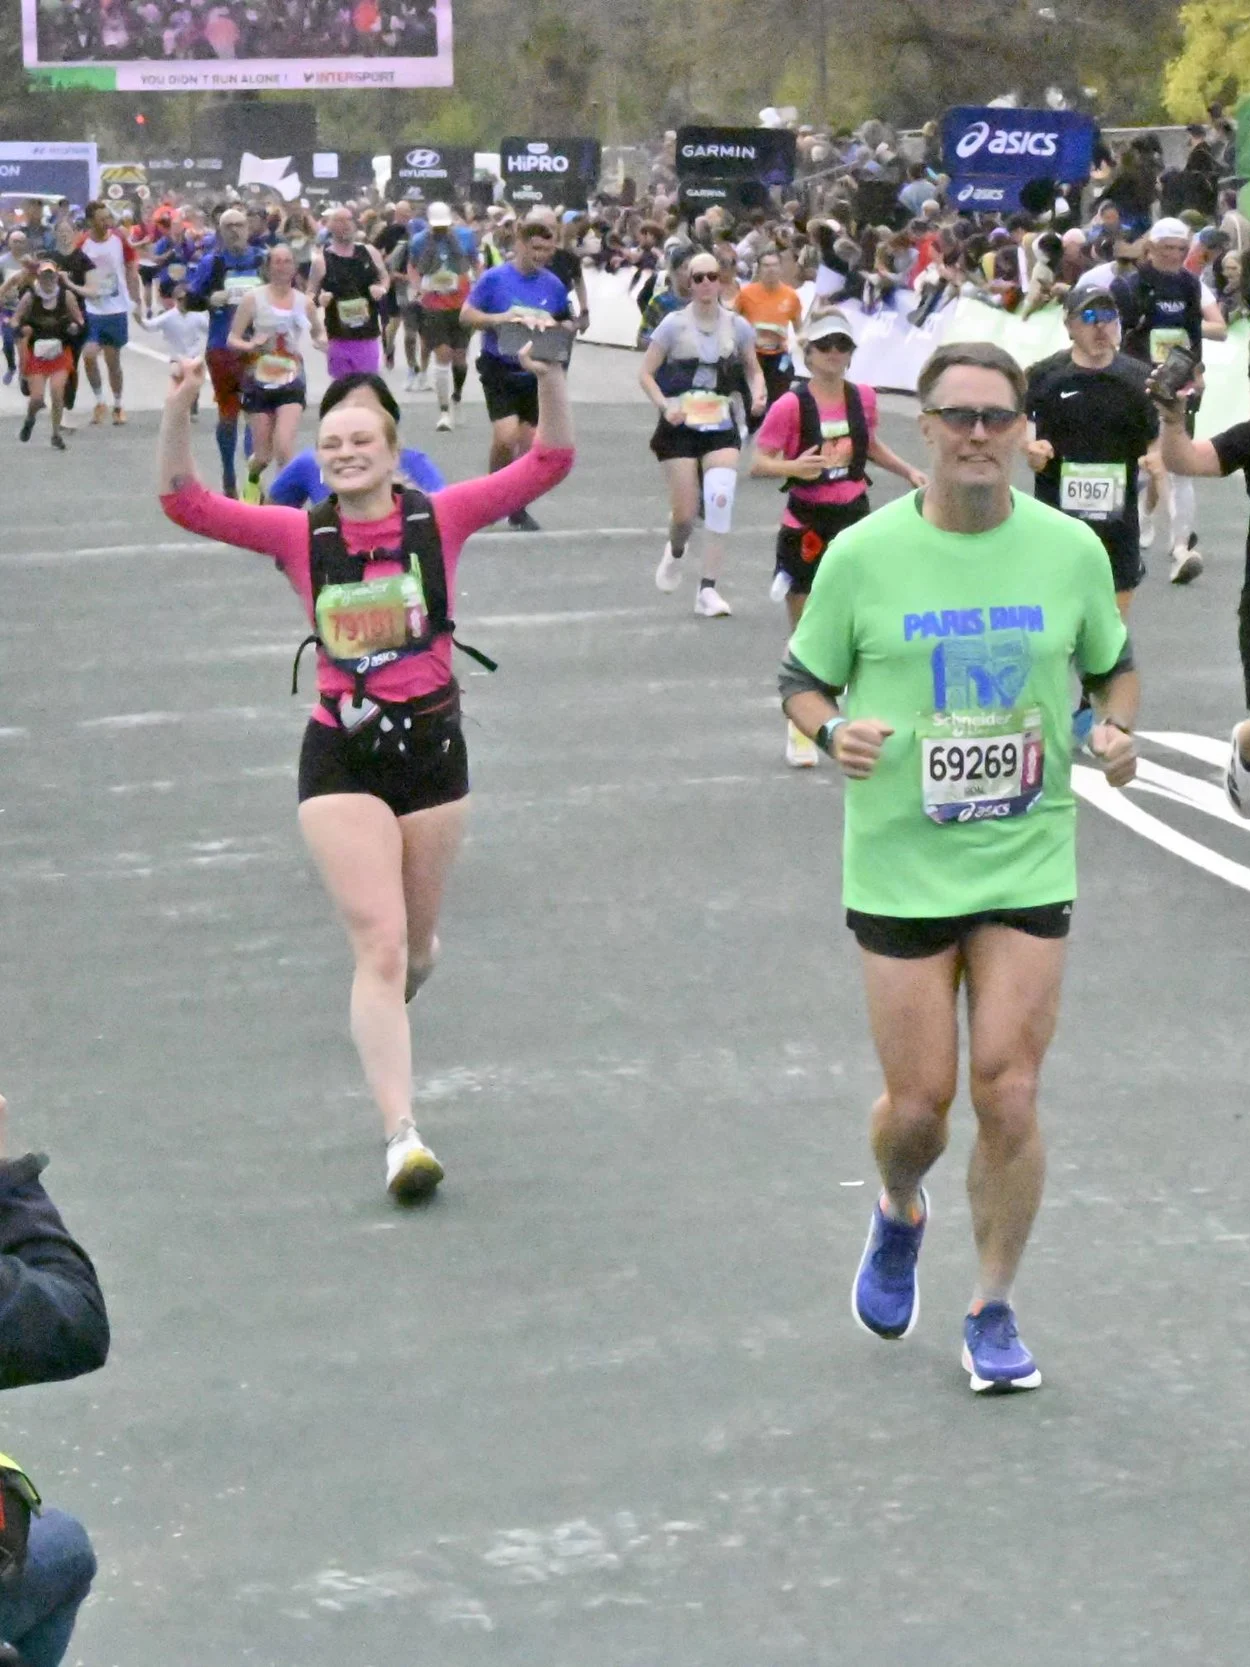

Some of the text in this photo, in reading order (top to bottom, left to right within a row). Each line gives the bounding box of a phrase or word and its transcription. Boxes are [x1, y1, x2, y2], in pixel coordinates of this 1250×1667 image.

[140, 74, 165, 85] YOU
[212, 73, 238, 84] RUN
[240, 72, 280, 83] ALONE
[316, 71, 396, 83] INTERSPORT
[988, 130, 1058, 156] asics
[682, 145, 755, 159] GARMIN
[1067, 481, 1109, 499] 61967
[929, 743, 1017, 782] 69269
